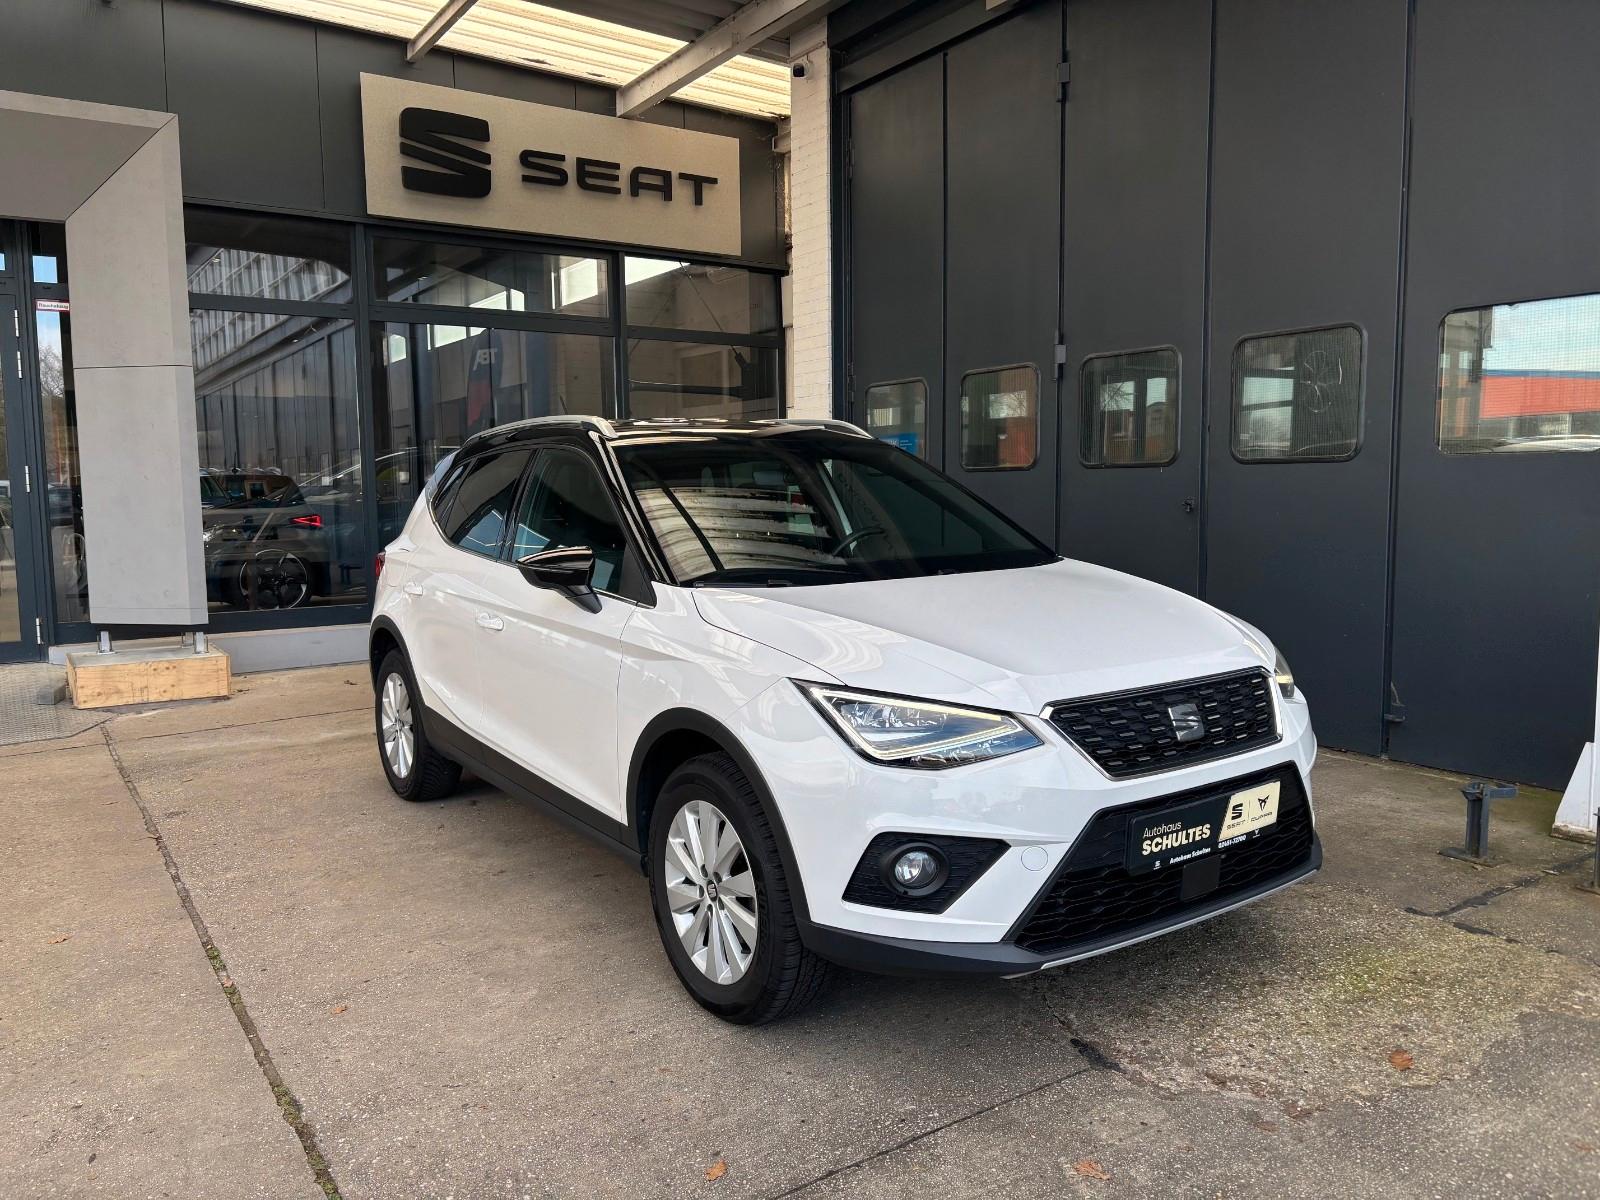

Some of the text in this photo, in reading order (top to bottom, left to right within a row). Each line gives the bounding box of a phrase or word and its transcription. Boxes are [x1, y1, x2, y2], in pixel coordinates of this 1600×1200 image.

[519, 149, 719, 206] SEAT
[473, 348, 498, 371] ABT
[1142, 823, 1211, 856] SCHULTES
[1143, 821, 1182, 838] Autohaus
